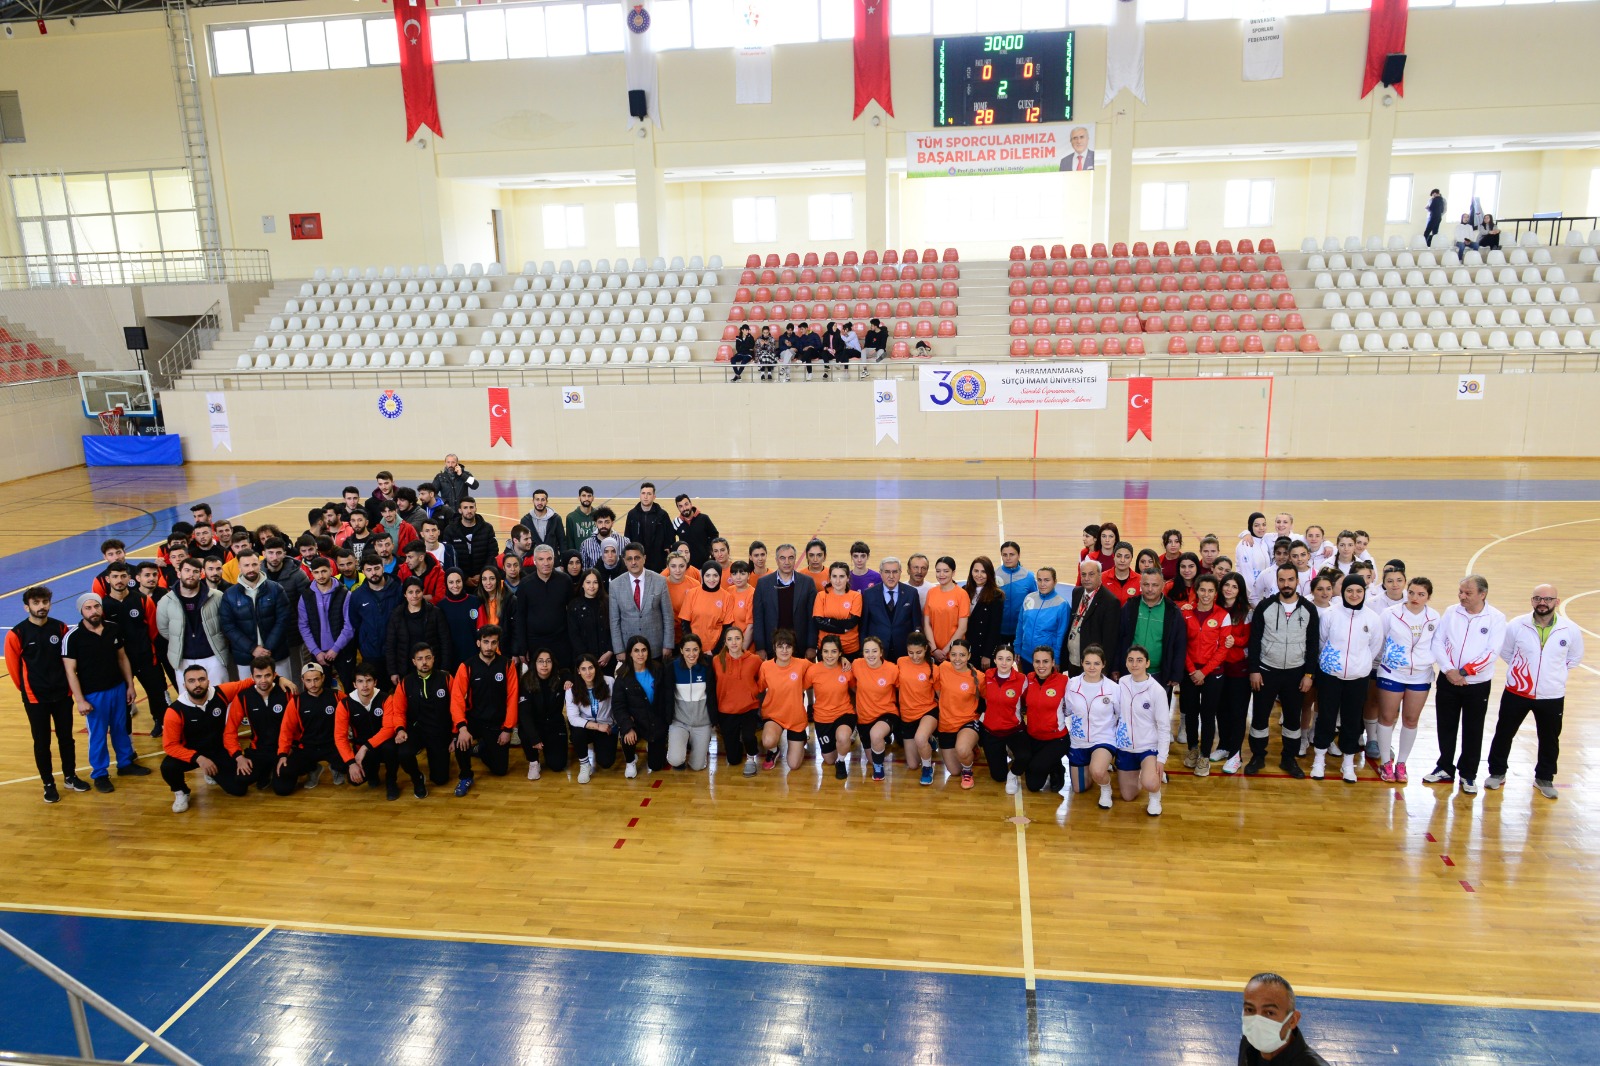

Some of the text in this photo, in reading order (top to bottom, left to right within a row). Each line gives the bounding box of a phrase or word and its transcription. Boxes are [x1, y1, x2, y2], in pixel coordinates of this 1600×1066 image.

[984, 34, 1024, 51] 30:00
[1247, 34, 1280, 43] FEDERASYONU
[982, 65, 992, 80] 0
[1023, 62, 1034, 78] 0
[998, 80, 1008, 95] 2
[973, 102, 988, 111] HOME
[1017, 100, 1035, 109] GUEST
[975, 109, 994, 125] 28
[1025, 107, 1040, 122] 12
[917, 132, 1056, 149] TÜM SPORCULARIMIZA
[917, 149, 997, 165] BAŞARILAR
[1015, 367, 1084, 375] KAHRAMANMARAŞ
[1001, 375, 1097, 385] SÜTÇÜ İMAM ÜNİVERSİTESİ
[819, 735, 830, 745] 10
